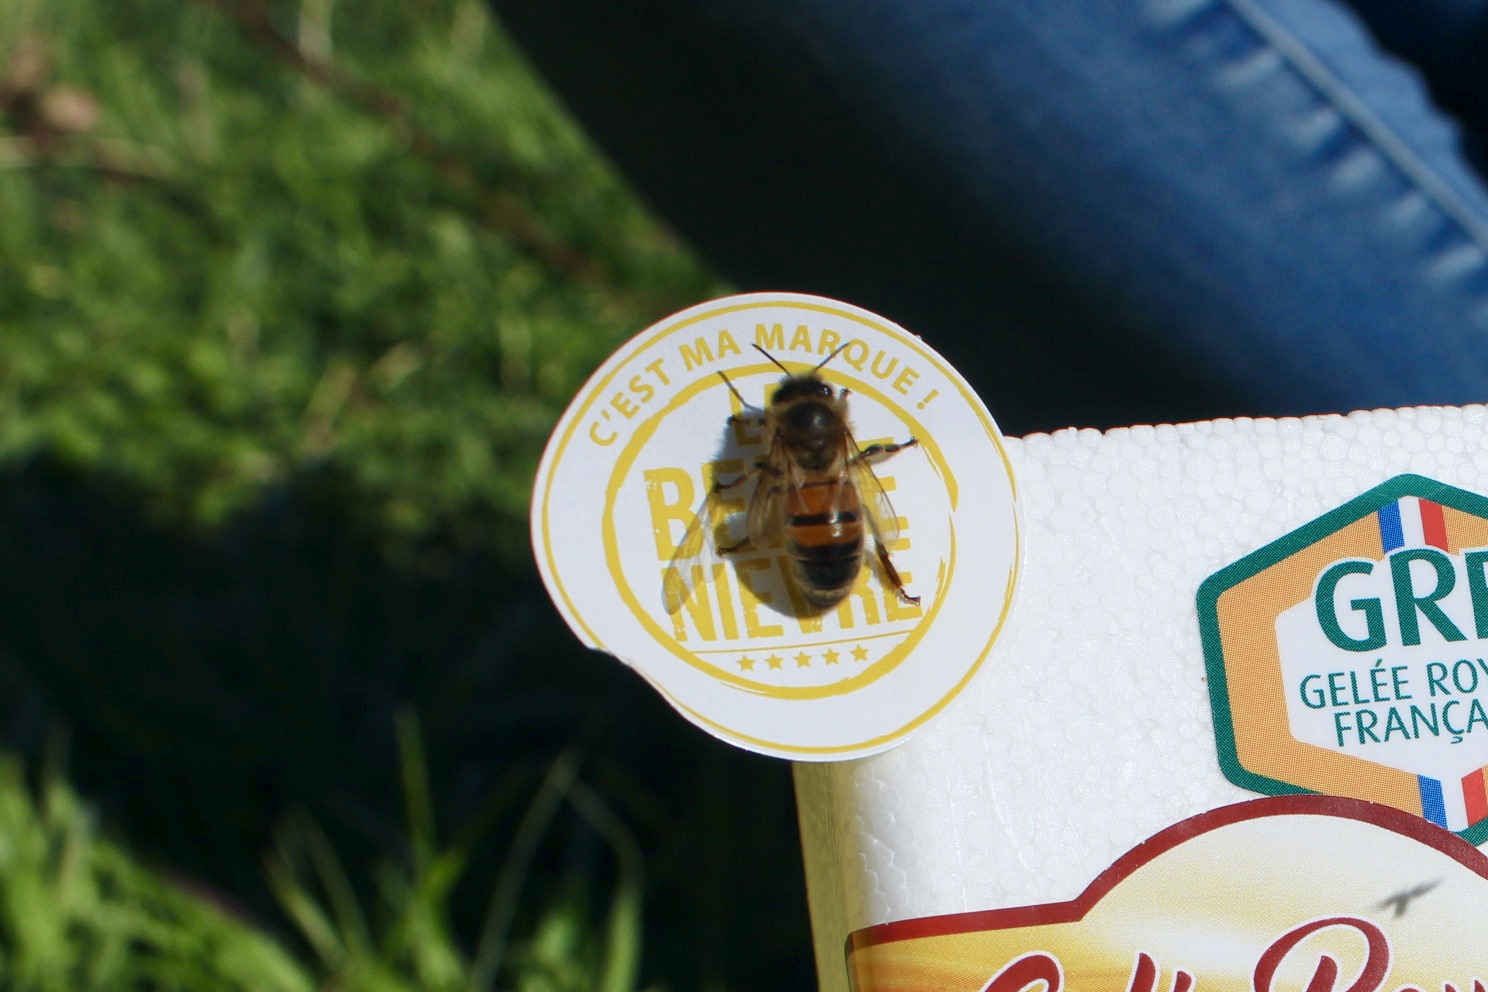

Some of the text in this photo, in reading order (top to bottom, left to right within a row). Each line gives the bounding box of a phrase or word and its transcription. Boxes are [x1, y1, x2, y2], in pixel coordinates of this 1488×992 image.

[589, 358, 671, 446] C'EST
[678, 329, 742, 371] MA
[755, 322, 921, 395] MARQUE
[1299, 659, 1413, 710] GELÉE
